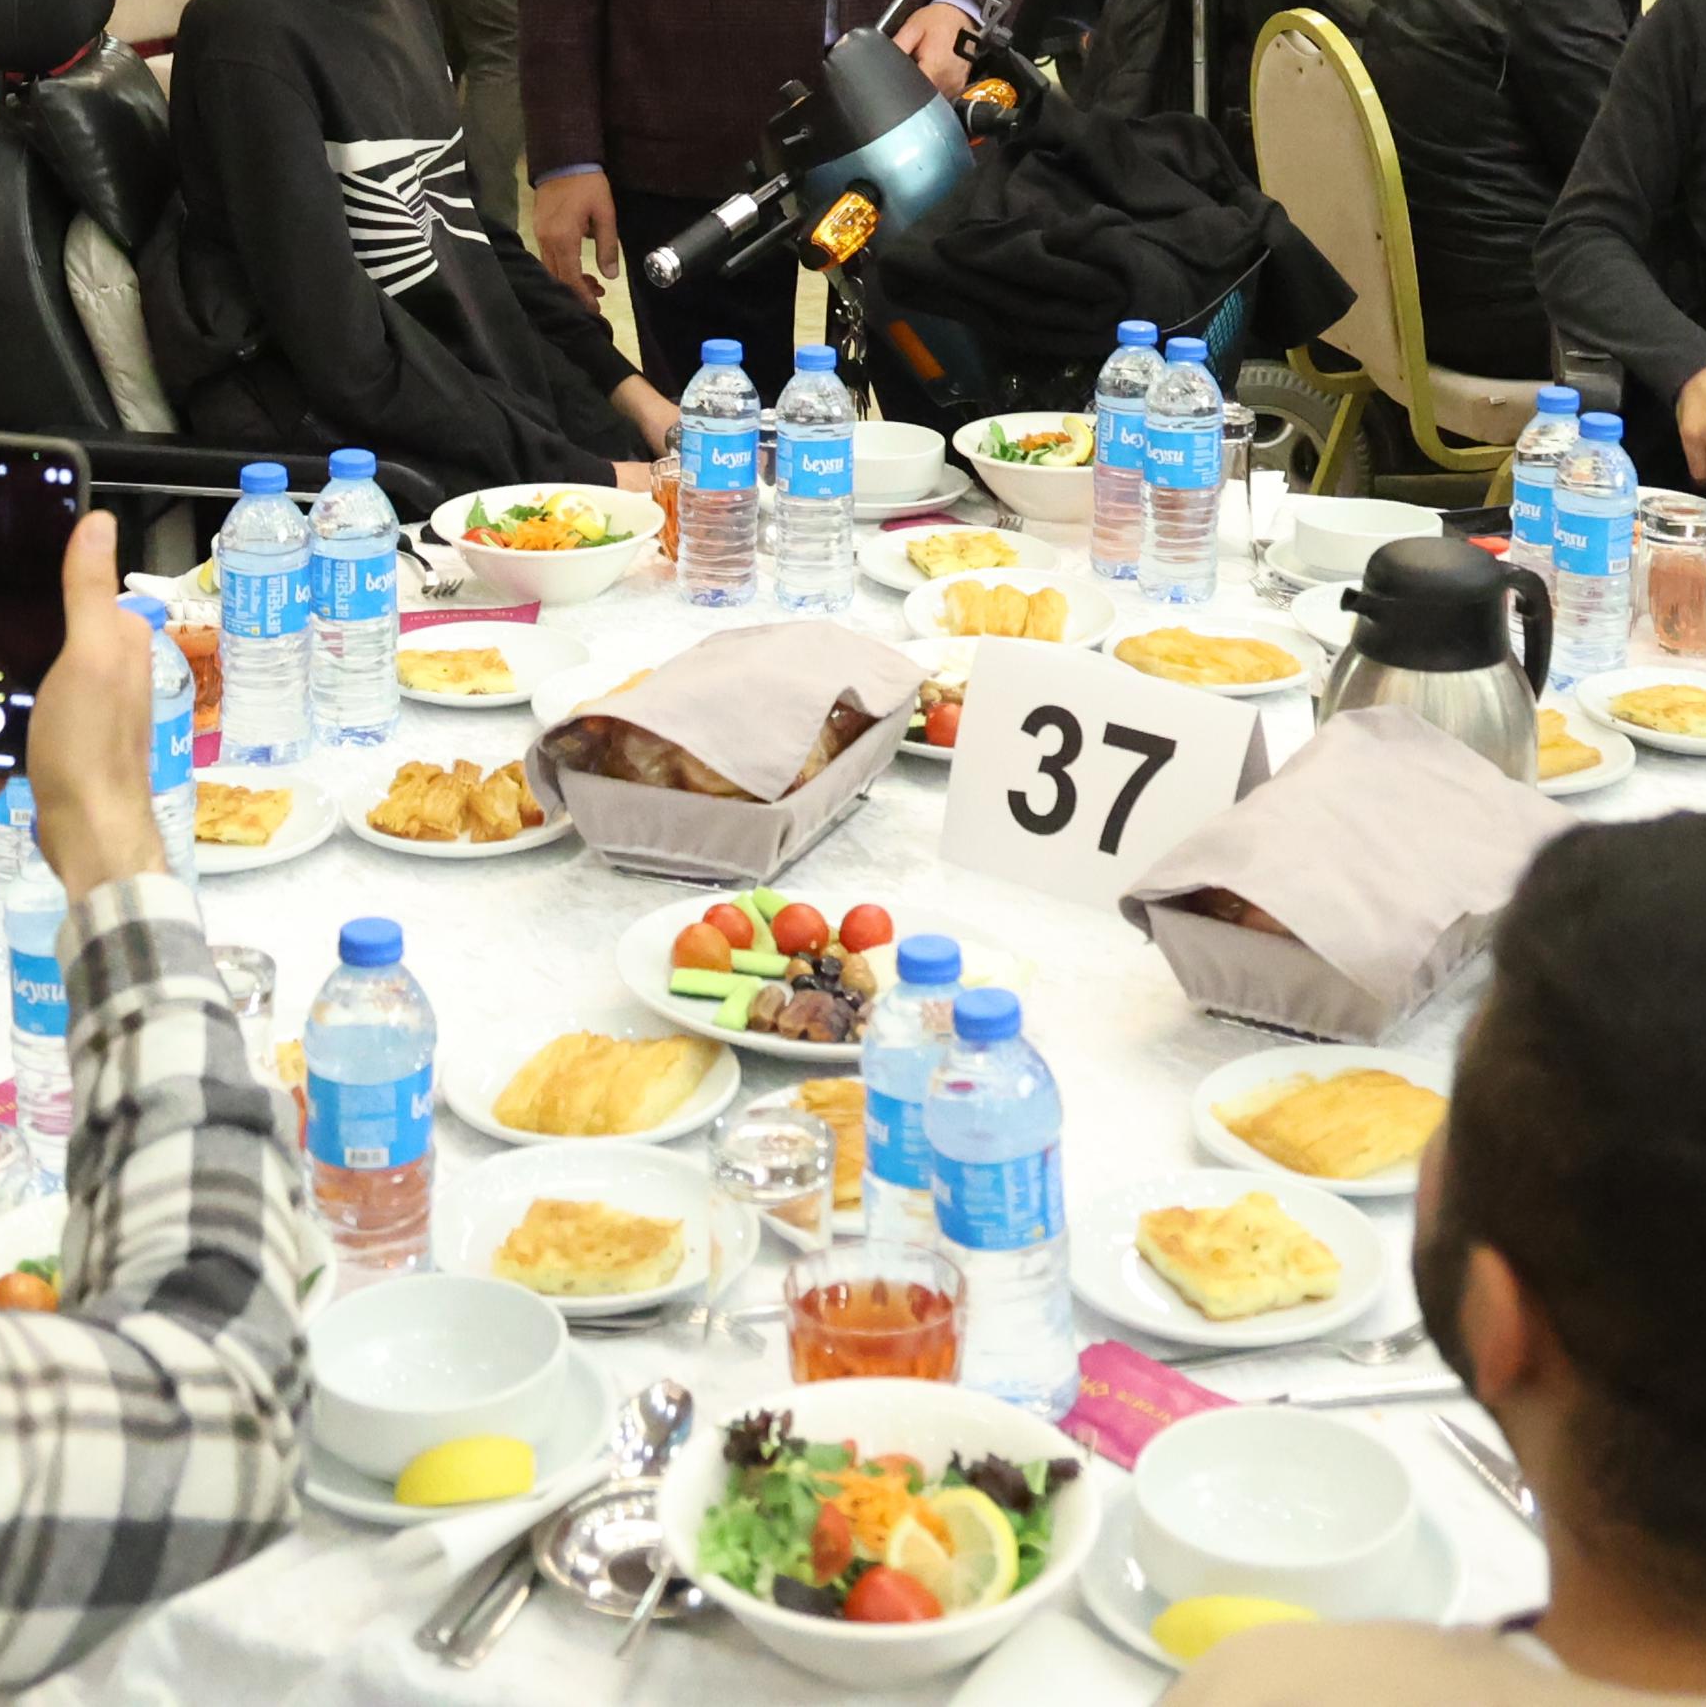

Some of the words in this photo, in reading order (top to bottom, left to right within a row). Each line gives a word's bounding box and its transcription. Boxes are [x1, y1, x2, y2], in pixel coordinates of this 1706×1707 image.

[1120, 426, 1145, 450] bey
[712, 447, 753, 469] beysu
[802, 453, 845, 477] beysu
[1007, 704, 1178, 857] 37
